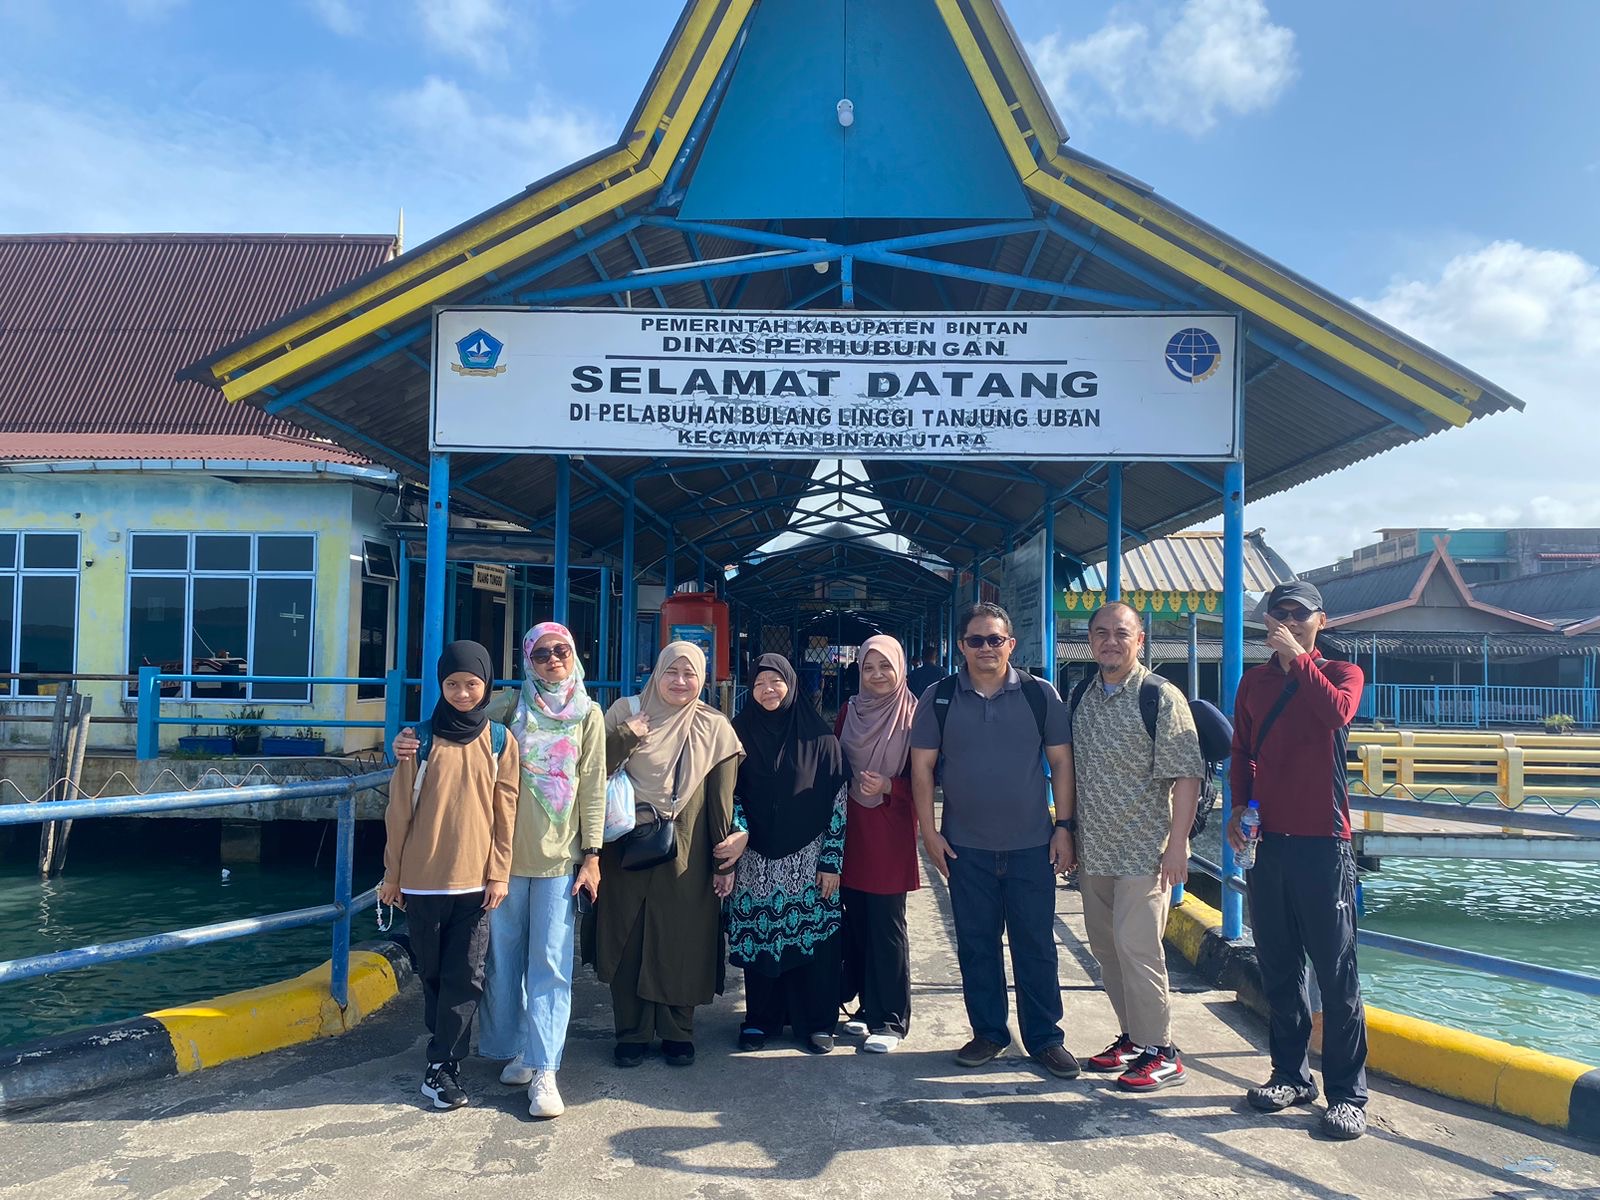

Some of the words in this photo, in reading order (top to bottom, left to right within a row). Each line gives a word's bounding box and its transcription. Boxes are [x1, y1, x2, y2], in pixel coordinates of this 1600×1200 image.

[641, 318, 788, 334] PEMERINTAH
[797, 319, 935, 335] KABUPATEN
[947, 321, 1028, 335] BINTAN
[663, 336, 757, 354] DINAS
[571, 365, 841, 397] SELAMAT
[868, 371, 1098, 398] DATANG
[570, 404, 591, 421] DI
[600, 404, 733, 425] PELABUHAN
[742, 406, 832, 426] BULANG
[838, 409, 912, 427] LINGGI
[922, 409, 1028, 427] TANJUNG
[1038, 409, 1100, 427] UBAN
[678, 430, 814, 446] KECAMATAN
[822, 432, 904, 448] BINTAN
[912, 434, 986, 448] UTARA
